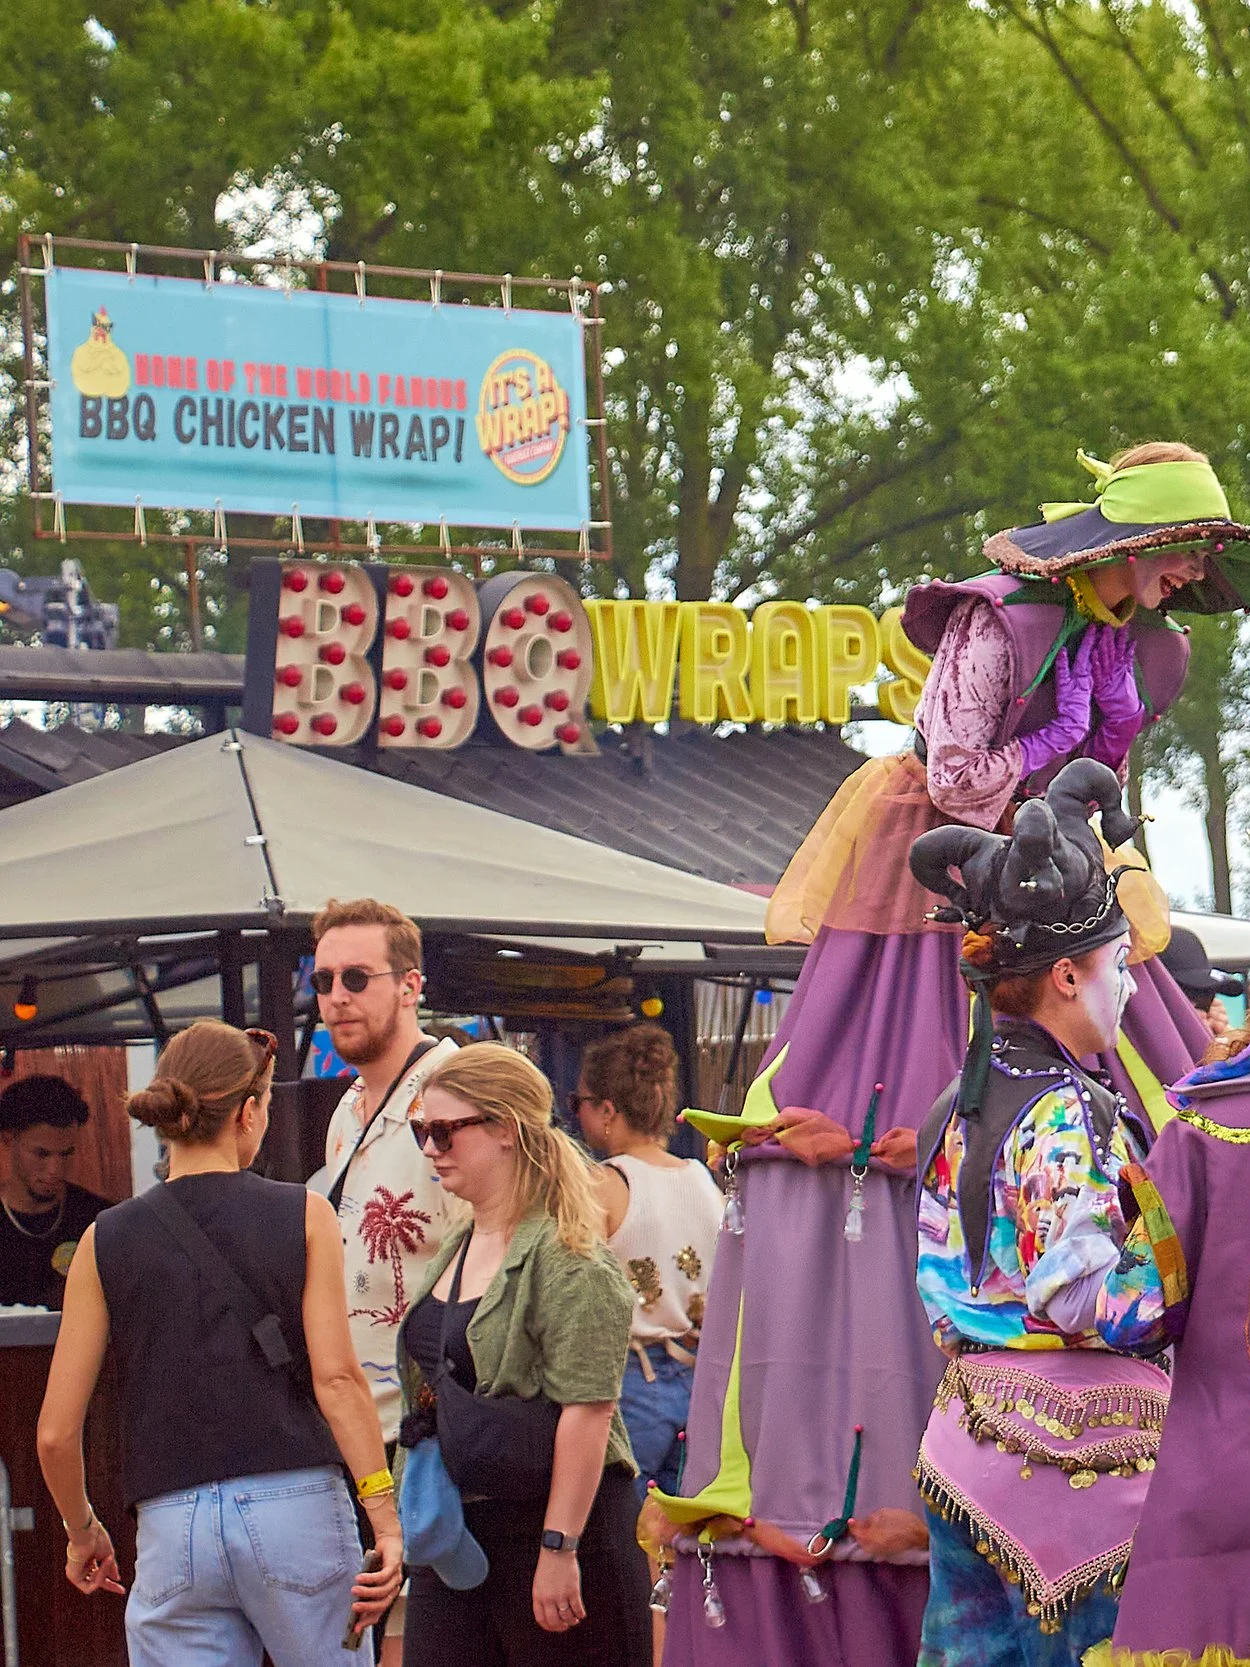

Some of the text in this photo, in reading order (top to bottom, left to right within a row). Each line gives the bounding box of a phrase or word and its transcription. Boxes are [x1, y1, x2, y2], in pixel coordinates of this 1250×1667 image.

[135, 353, 467, 411] HOME OF THE WORLD FAMOUS
[536, 362, 554, 393] A
[79, 392, 156, 442] BBQ
[174, 395, 335, 455] CHICKEN
[351, 409, 465, 463] WRAP!
[475, 387, 570, 458] WRAP!
[268, 562, 932, 756] BBQ WRAPS
